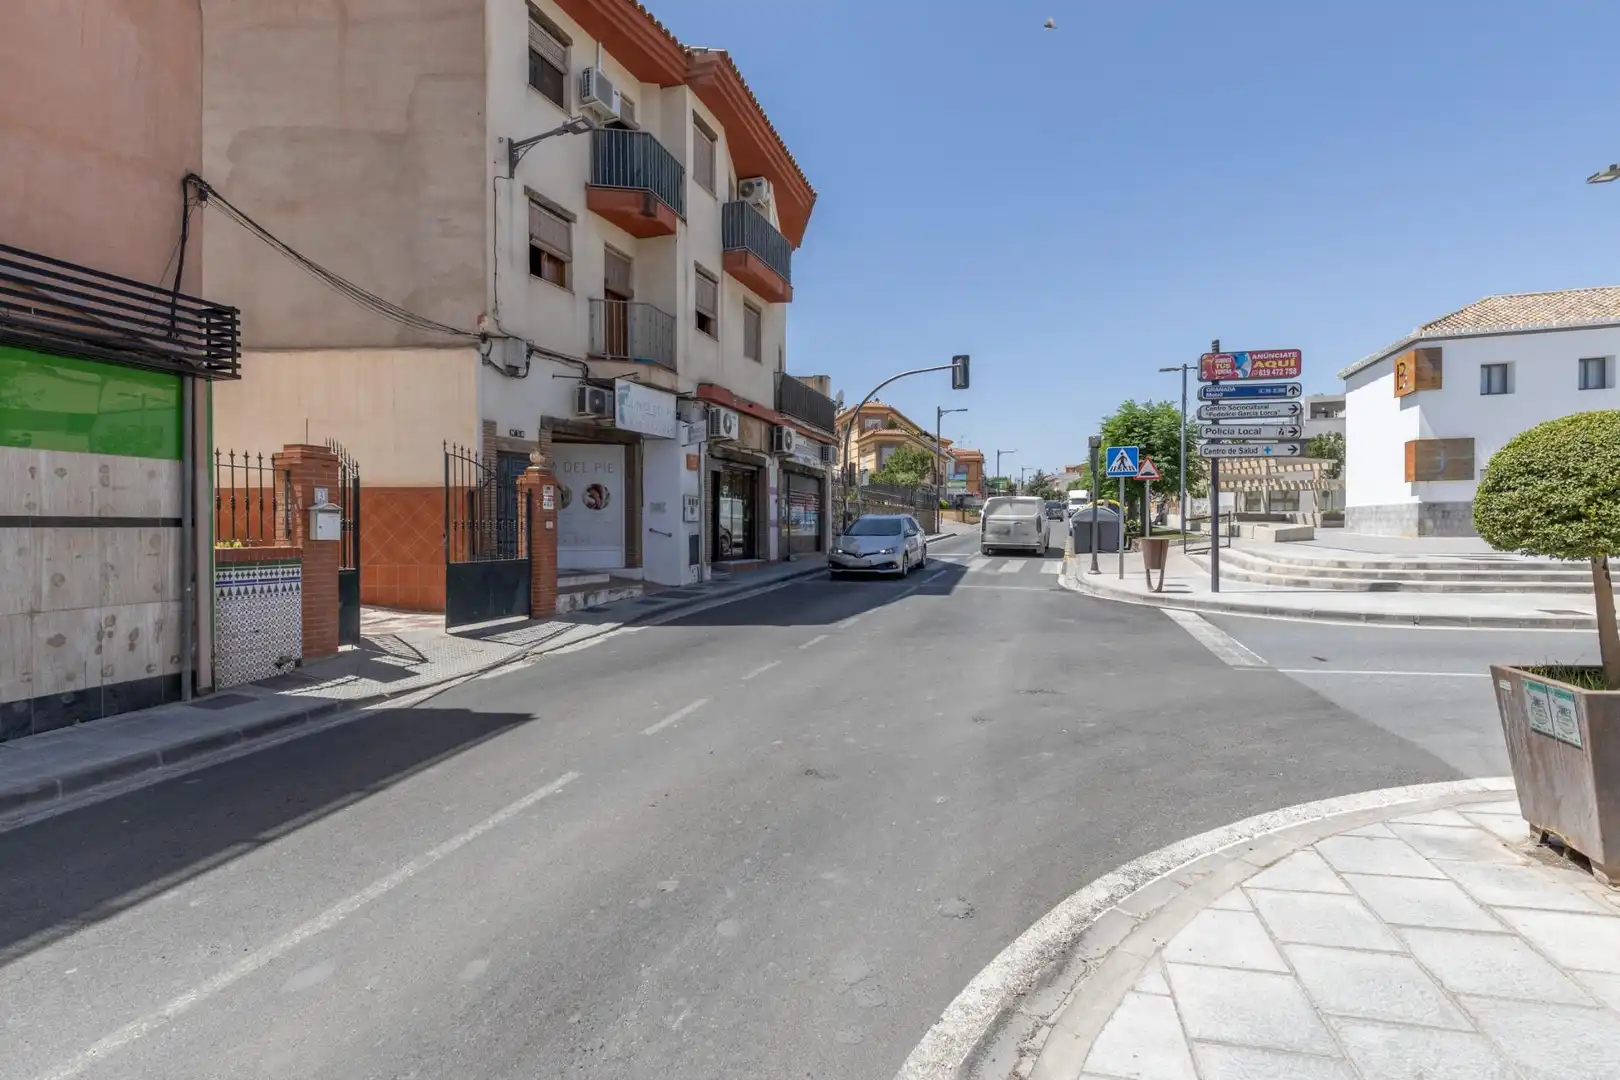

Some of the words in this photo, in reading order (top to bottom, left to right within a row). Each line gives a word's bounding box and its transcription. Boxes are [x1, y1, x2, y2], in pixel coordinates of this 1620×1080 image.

[1254, 358, 1296, 368] AQUÍ
[1271, 368, 1284, 376] 472
[1205, 427, 1235, 436] Policía
[1238, 427, 1262, 436] Local
[1203, 447, 1226, 455] Centro
[1228, 447, 1237, 455] de
[1239, 446, 1258, 455] Salud
[563, 461, 588, 474] DEL
[594, 461, 614, 474] PIE
